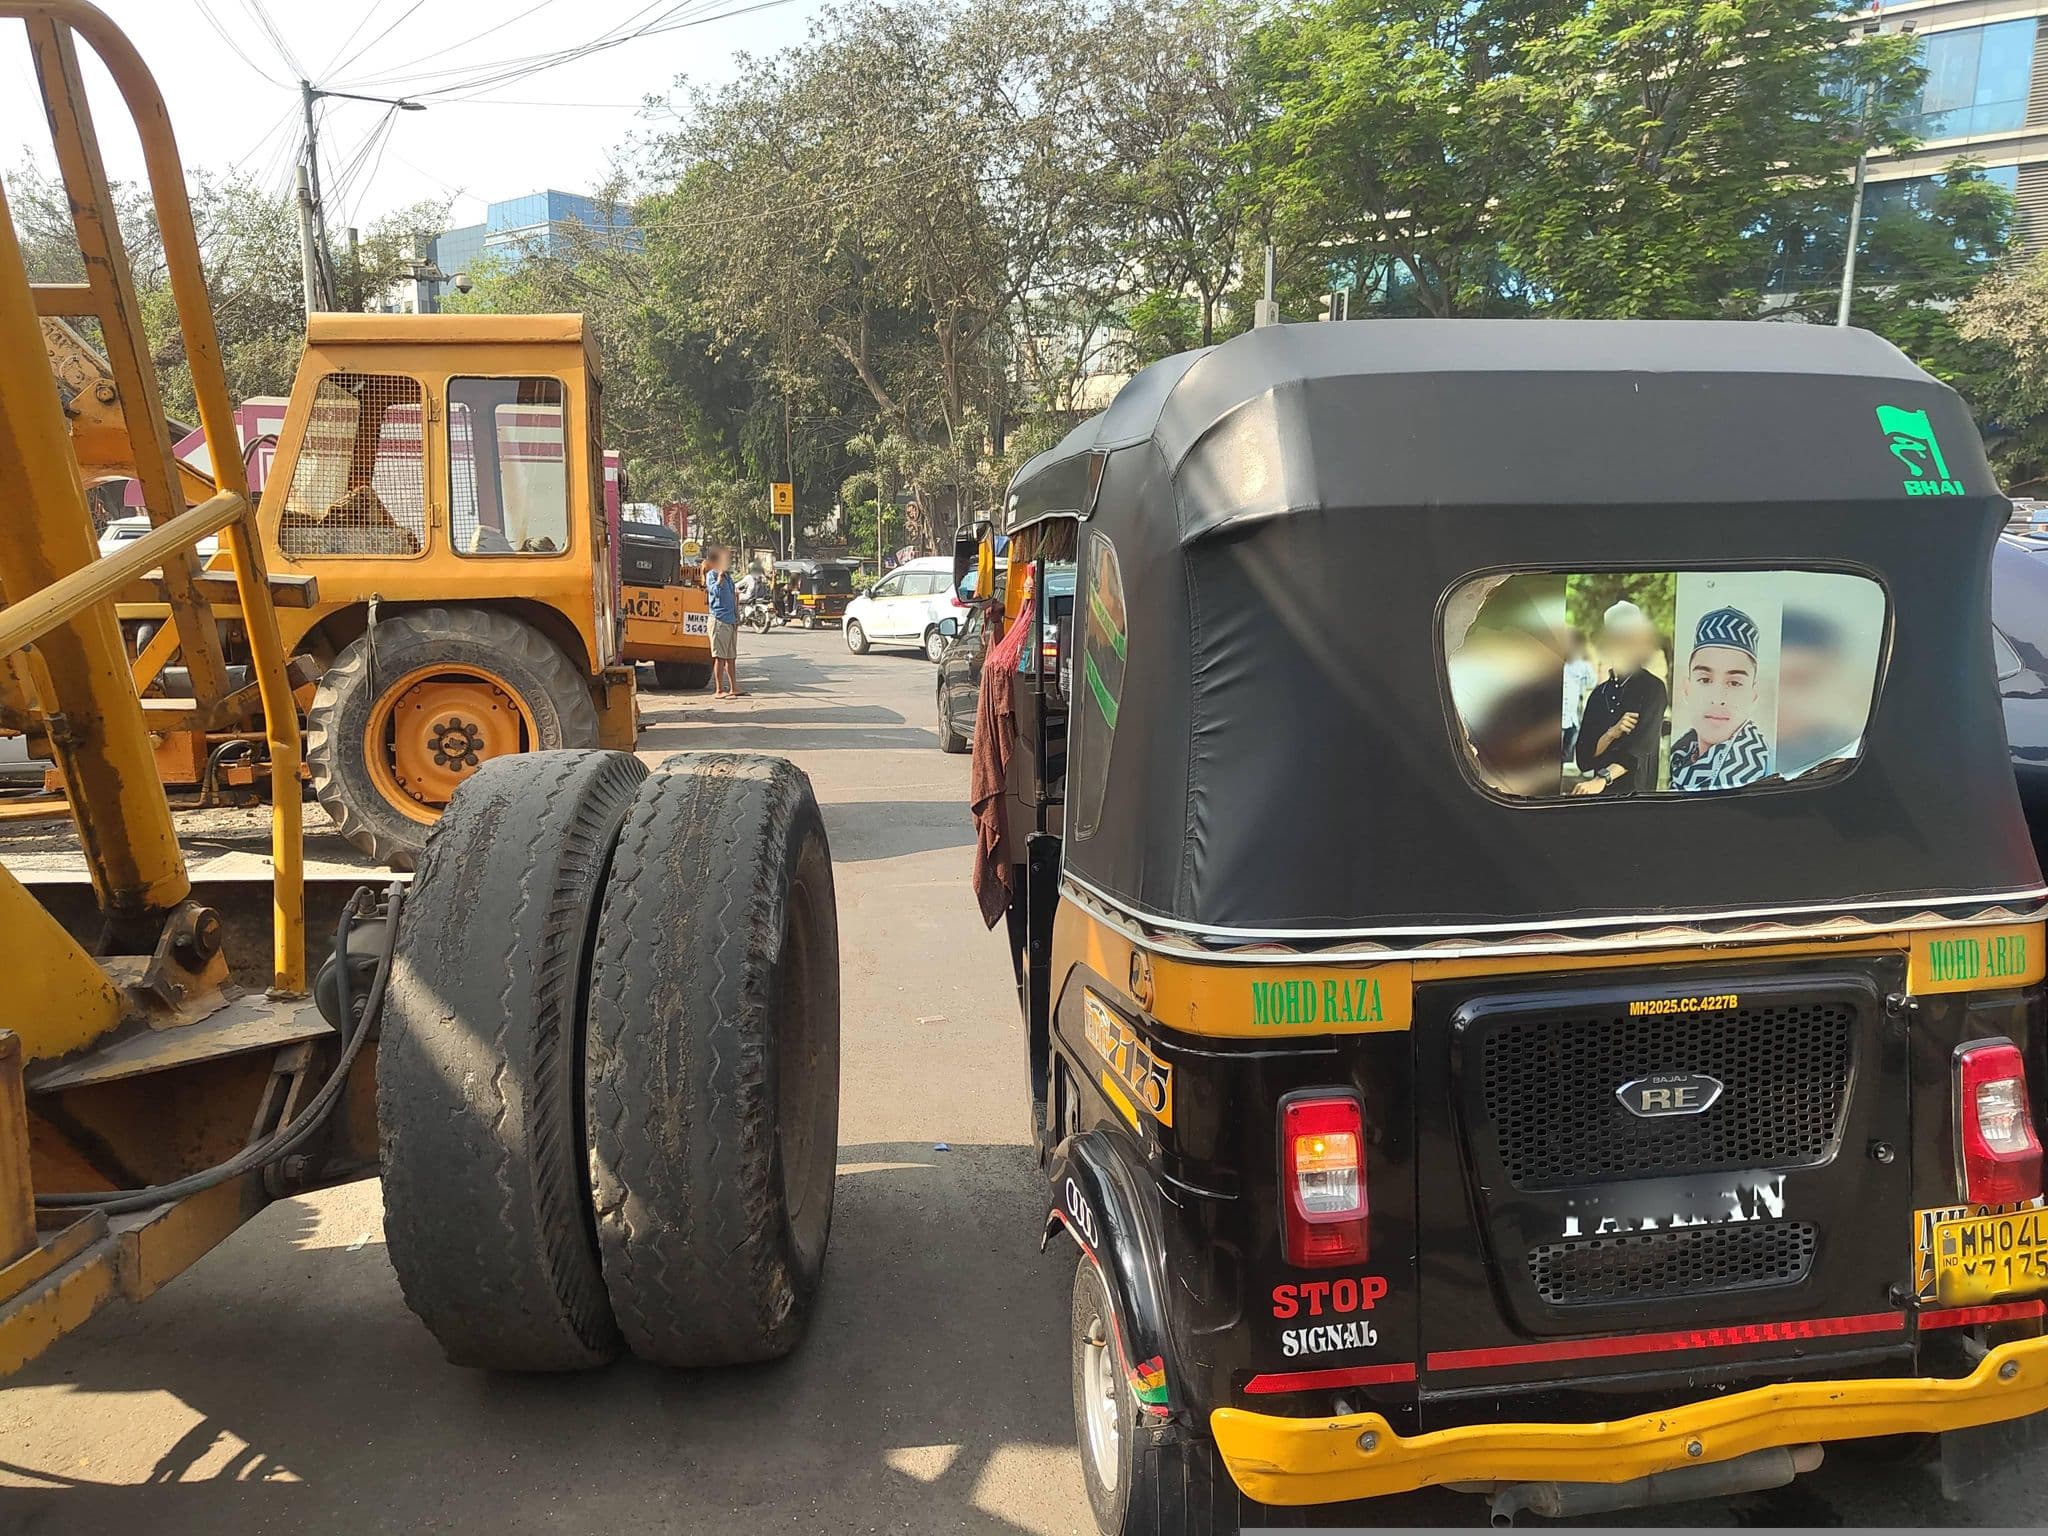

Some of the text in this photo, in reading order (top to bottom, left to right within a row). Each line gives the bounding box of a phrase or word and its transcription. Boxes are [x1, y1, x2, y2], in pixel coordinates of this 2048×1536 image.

[1903, 480, 1965, 496] BHAI
[625, 599, 661, 618] ACE
[1929, 935, 2026, 982] MOHD ARIB
[1252, 978, 1383, 1025] MOHD RAZA
[1629, 995, 1739, 1016] MH2025.CC.4227B
[1652, 1075, 1688, 1084] BAJAJ
[1641, 1086, 1699, 1111] RE
[1942, 1256, 1959, 1268] IND
[1272, 1276, 1388, 1319] STOP
[1281, 1320, 1378, 1357] SIGNAL
